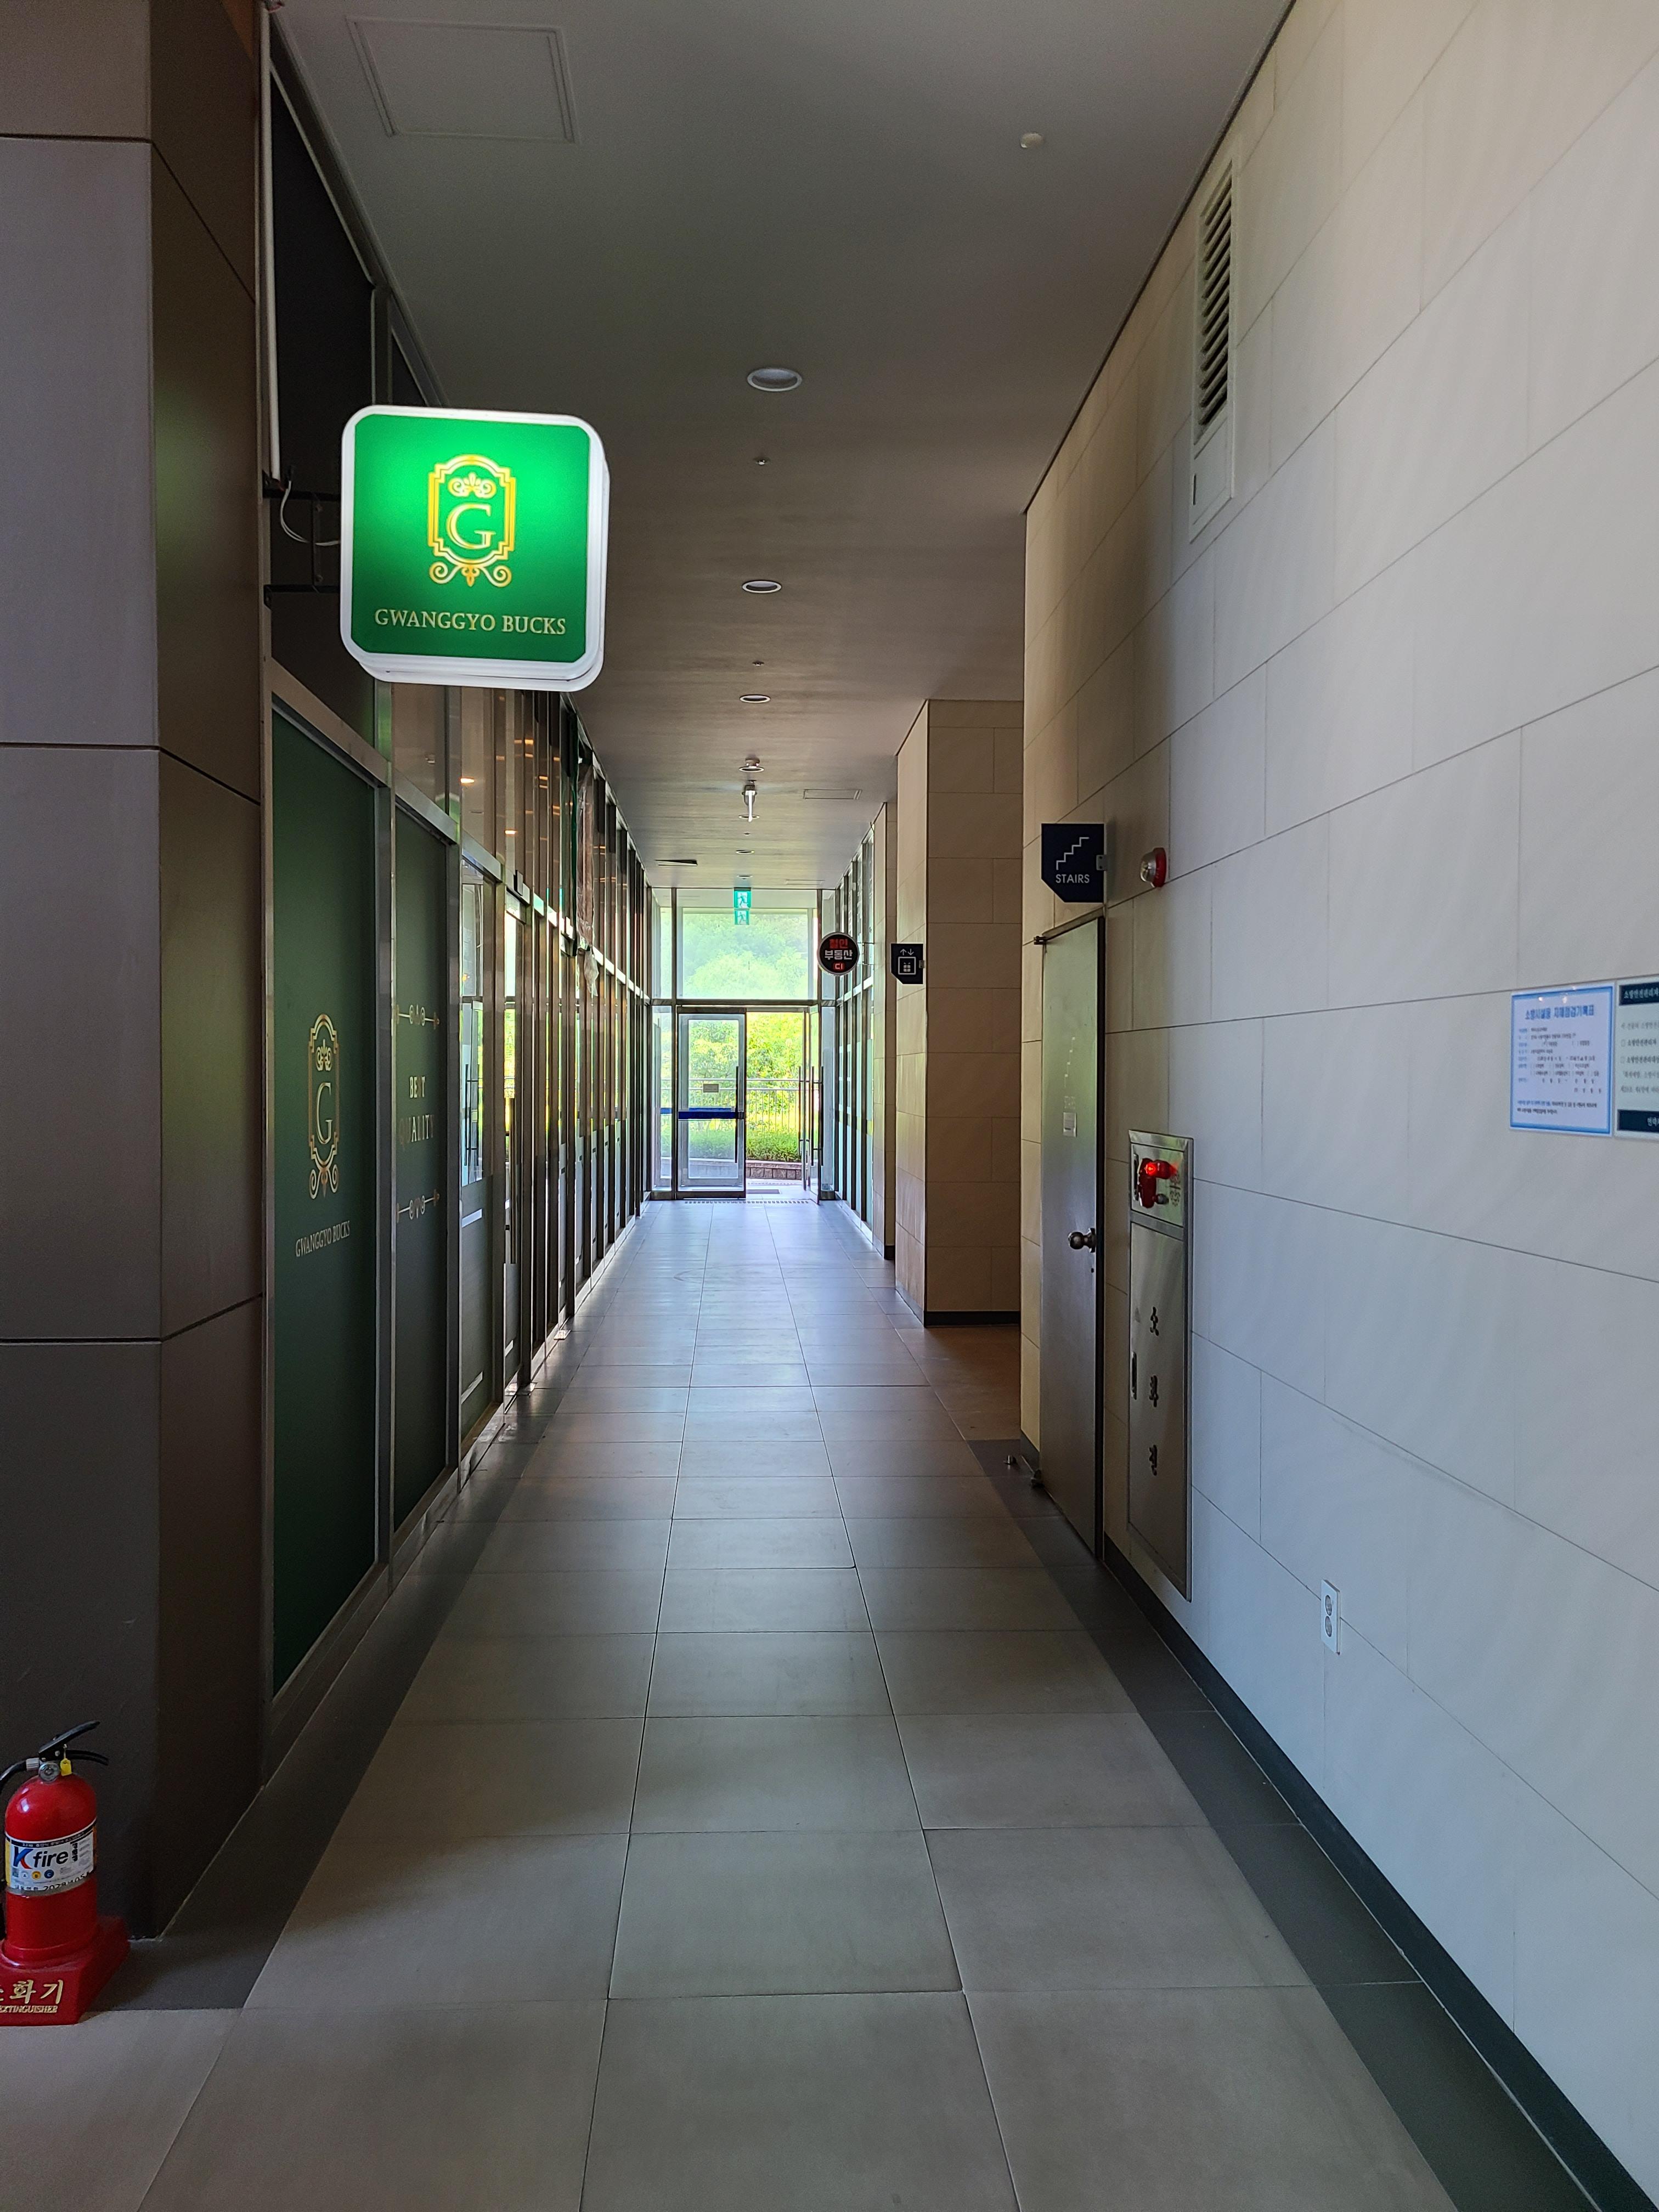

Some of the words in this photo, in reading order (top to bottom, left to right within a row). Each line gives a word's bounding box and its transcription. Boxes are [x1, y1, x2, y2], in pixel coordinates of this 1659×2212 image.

[446, 504, 496, 550] G
[375, 609, 495, 631] GWANGGYO
[501, 616, 566, 635] BUCKS
[1055, 873, 1090, 884] STAIRS
[825, 950, 853, 960] 부동산
[317, 1082, 332, 1144] G
[296, 1227, 331, 1257] GWANGGYO
[333, 1220, 350, 1243] BUCKS
